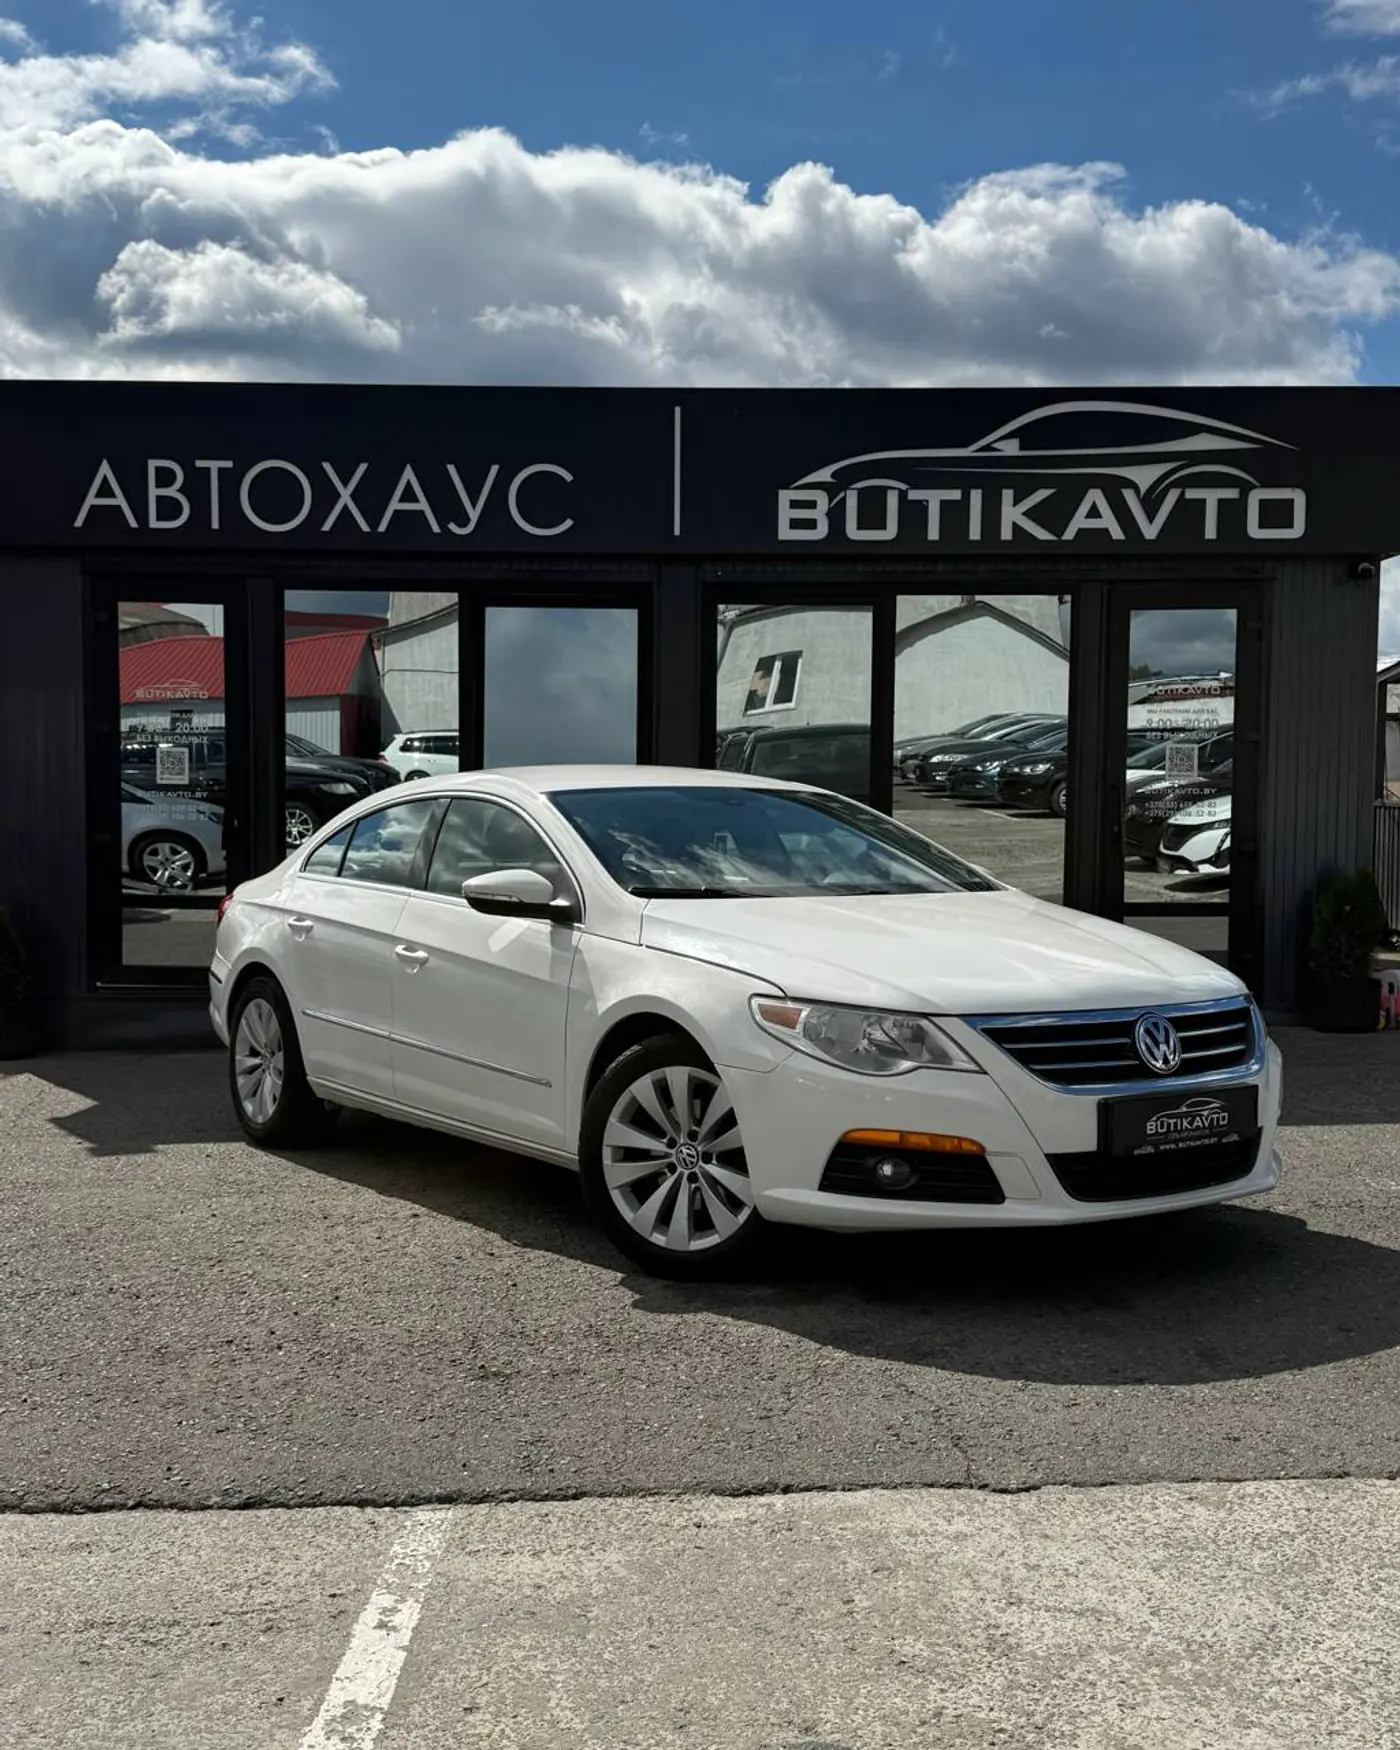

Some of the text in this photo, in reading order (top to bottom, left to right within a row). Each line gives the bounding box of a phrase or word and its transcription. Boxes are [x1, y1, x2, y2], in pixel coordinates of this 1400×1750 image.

[73, 458, 575, 536] АВТОХАУС
[777, 487, 1307, 541] BUTIKAVTO
[1146, 1112, 1229, 1135] BUTIKAVTO
